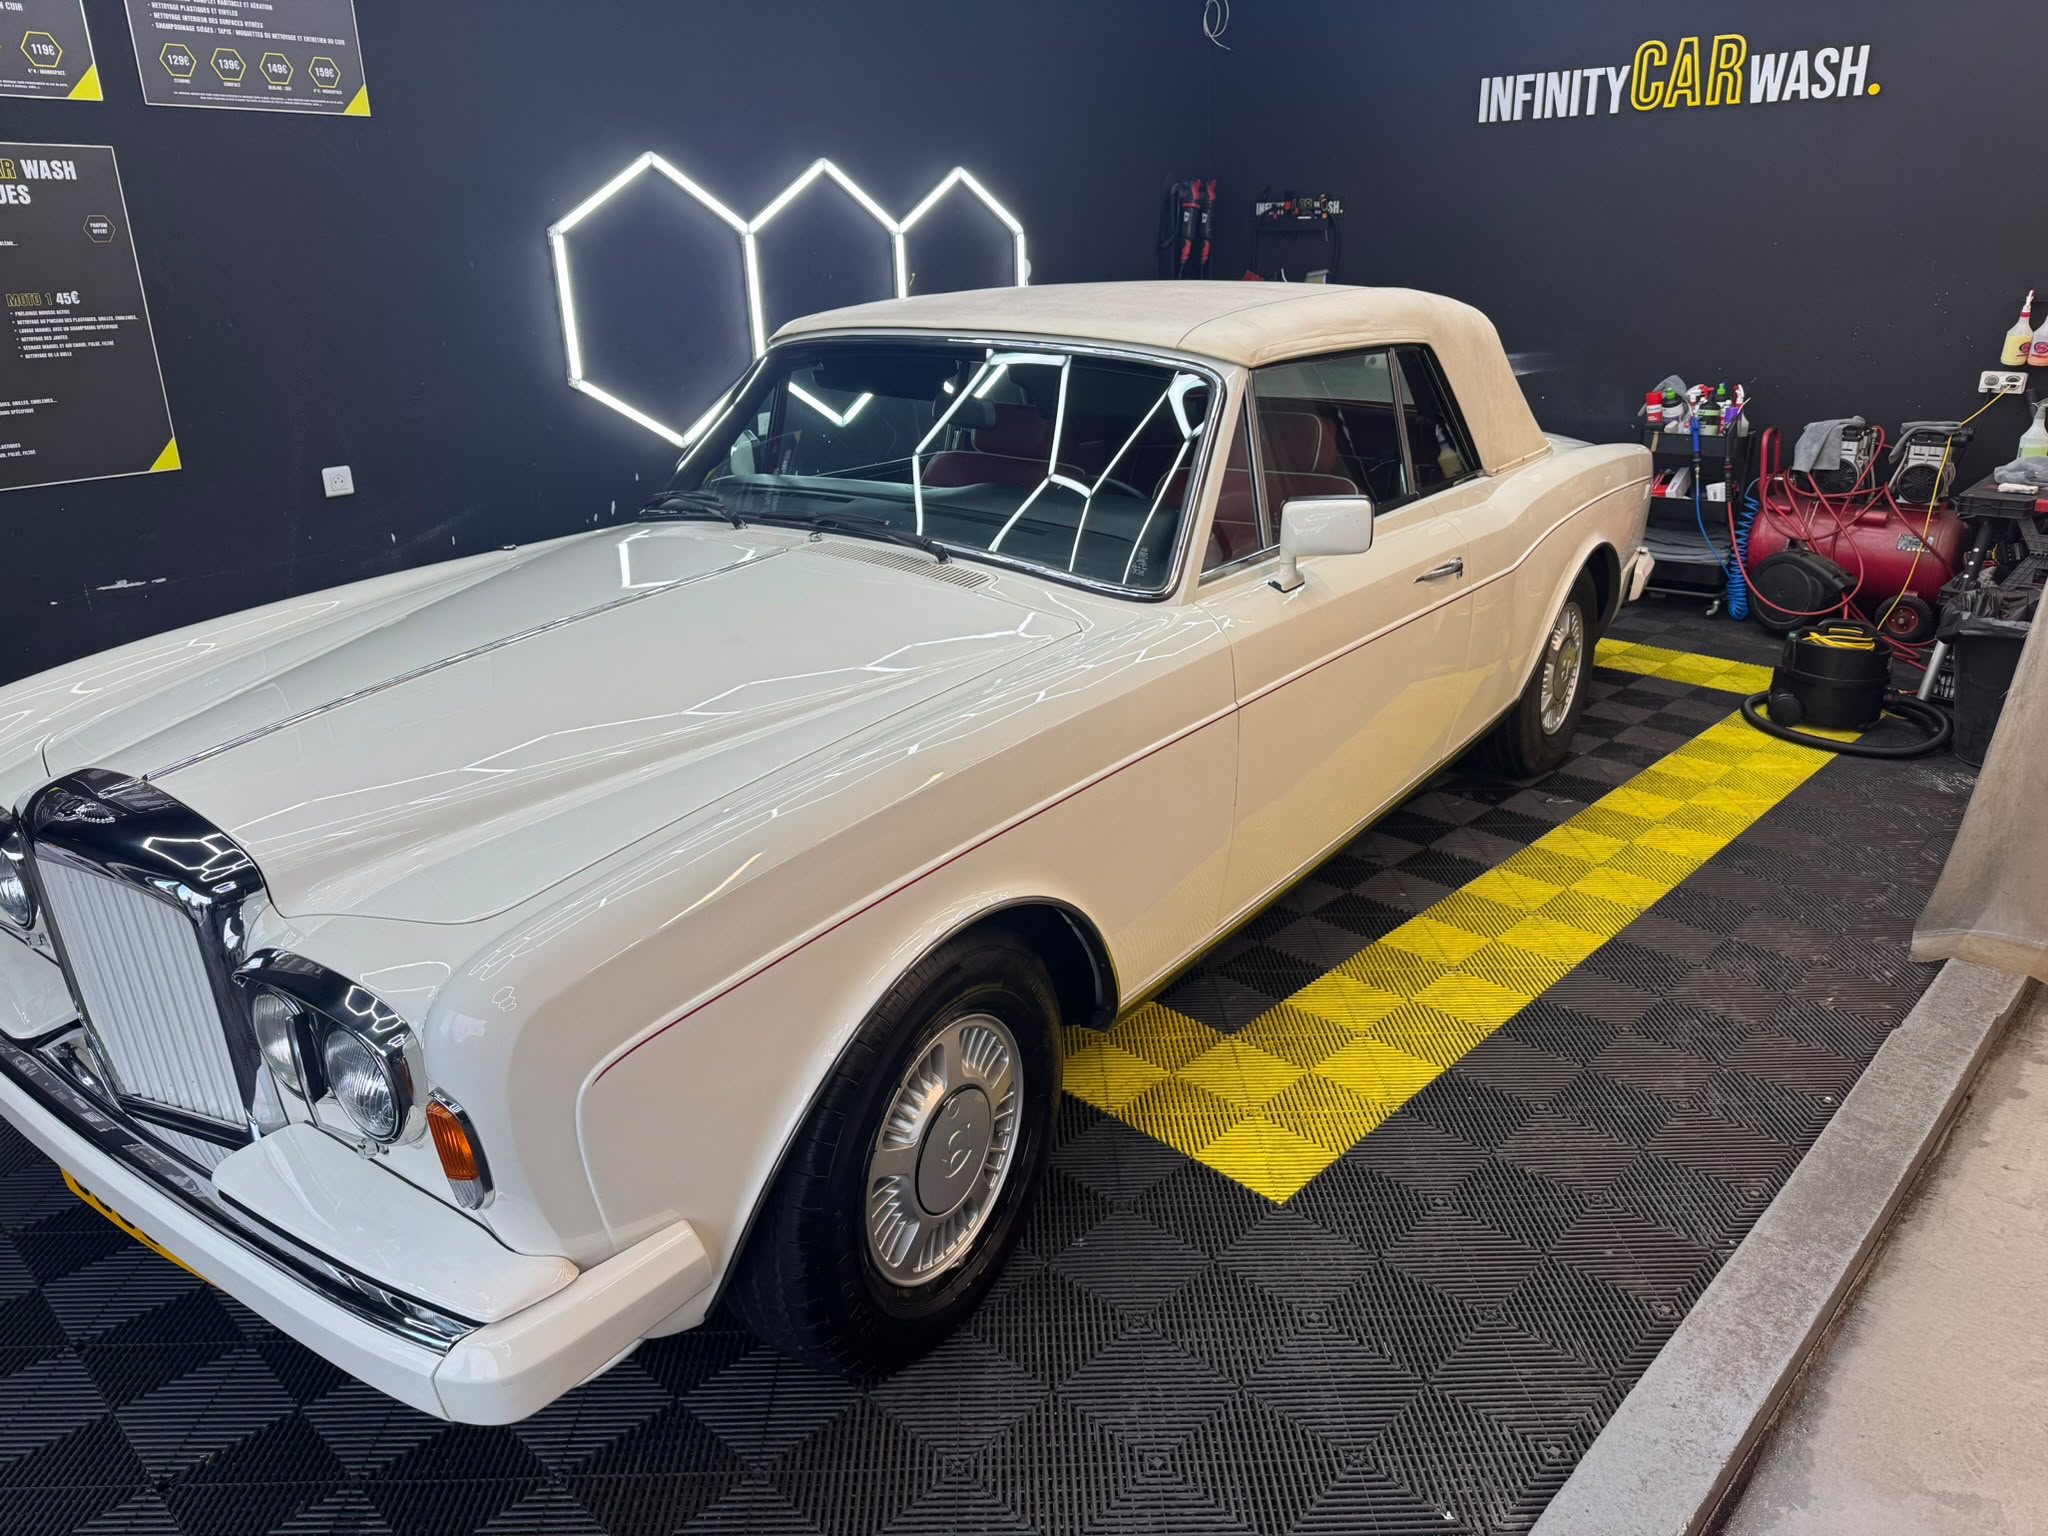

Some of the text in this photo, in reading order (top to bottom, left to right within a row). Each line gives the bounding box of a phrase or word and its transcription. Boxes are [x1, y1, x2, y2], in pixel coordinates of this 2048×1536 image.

[5, 2, 23, 11] CUIR
[31, 43, 55, 56] 119€
[168, 54, 190, 66] 129€
[218, 59, 240, 70] 139€
[267, 63, 288, 74] 149€
[315, 67, 334, 78] 159€
[1478, 34, 1880, 124] INFINITY CAR WASH.
[20, 159, 77, 180] WASH
[6, 290, 80, 307] MOTO 1 45€
